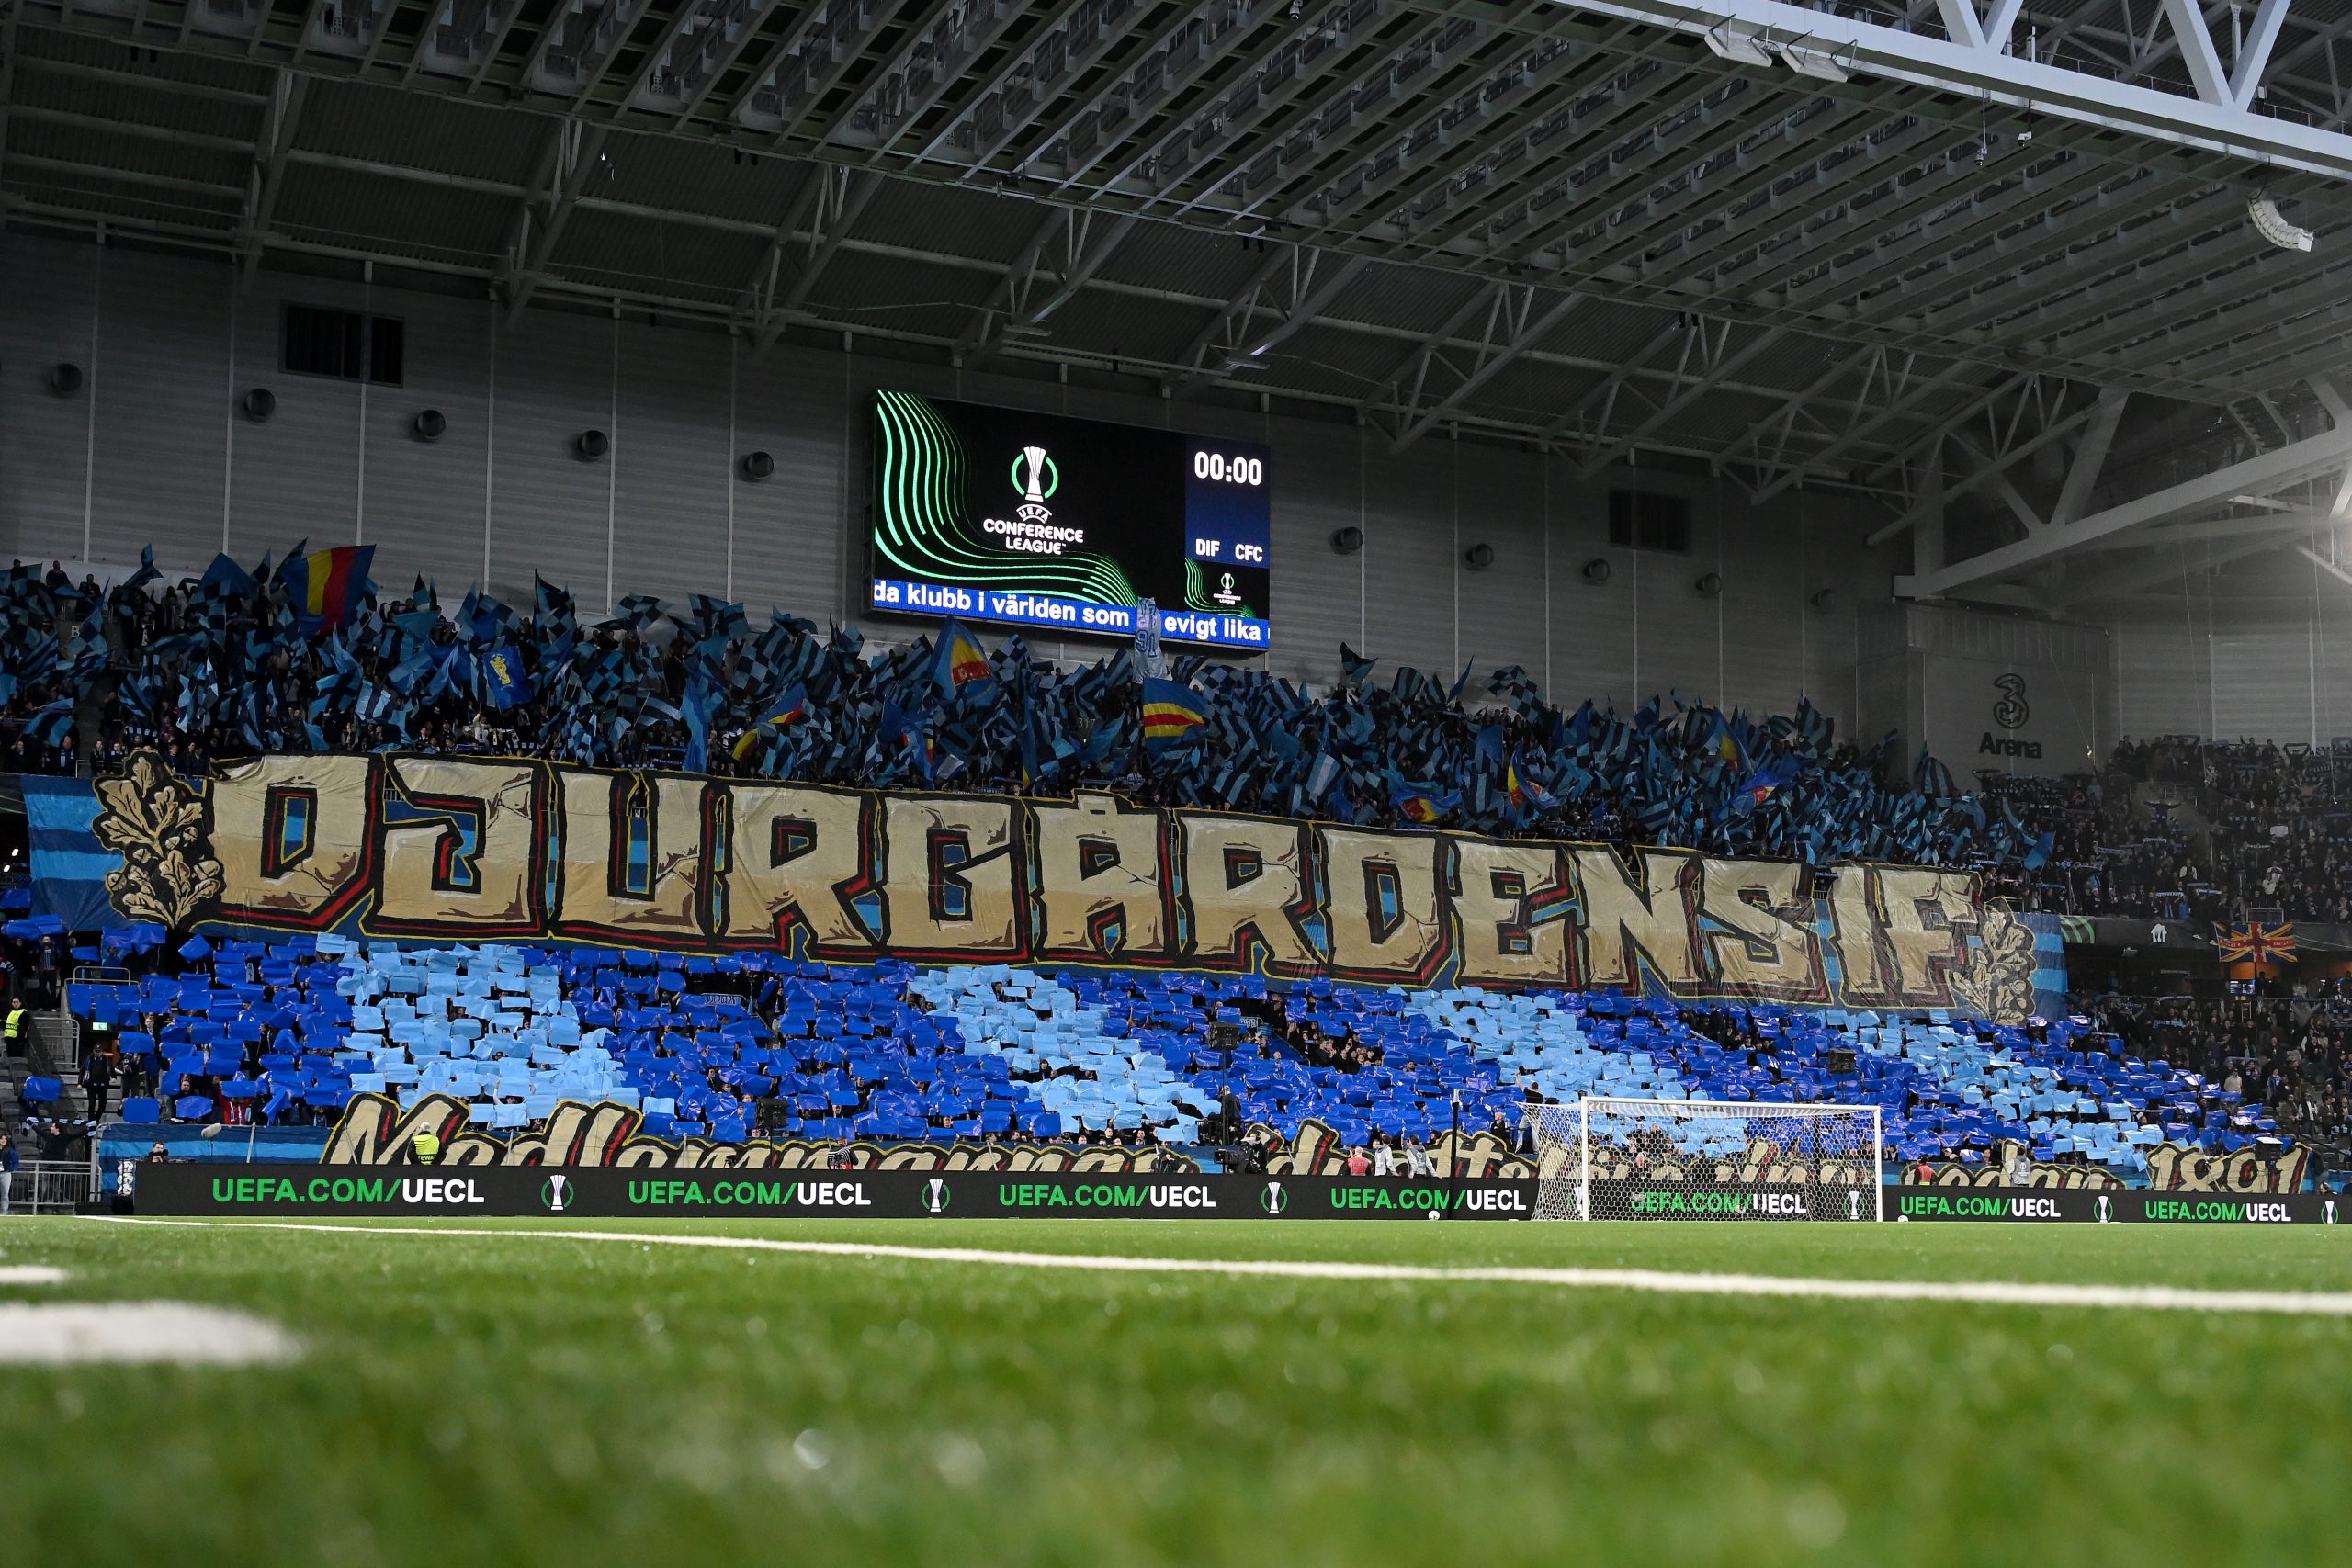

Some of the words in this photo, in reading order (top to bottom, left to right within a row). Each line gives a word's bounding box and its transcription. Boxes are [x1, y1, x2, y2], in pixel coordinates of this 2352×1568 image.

[1194, 451, 1262, 486] 00:00
[1018, 506, 1049, 523] UEFA
[983, 518, 1084, 543] CONFERENCE
[1005, 536, 1062, 556] LEAGUE
[1195, 538, 1221, 557] DIF
[1235, 544, 1263, 562] CFC
[874, 580, 899, 604] da
[907, 582, 971, 611] klubb
[978, 591, 985, 612] i
[992, 593, 1078, 622] världen
[1082, 607, 1130, 627] som
[1163, 614, 1218, 641] evigt
[1223, 617, 1261, 641] lika
[1978, 731, 2042, 759] Arena
[198, 751, 1833, 1007] DJURGÅRDENS
[1833, 861, 1984, 1009] IF
[212, 1178, 485, 1203] UEFA.COM/UECL
[628, 1180, 872, 1206] UEFA.COM/UECL
[999, 1184, 1217, 1208] UEFA.COM/UECL
[1331, 1188, 1527, 1211] UEFA.COM/UECL
[1900, 1196, 2062, 1218] UEFA.COM/UECL
[2144, 1201, 2292, 1222] UEFA.COM/UECL
